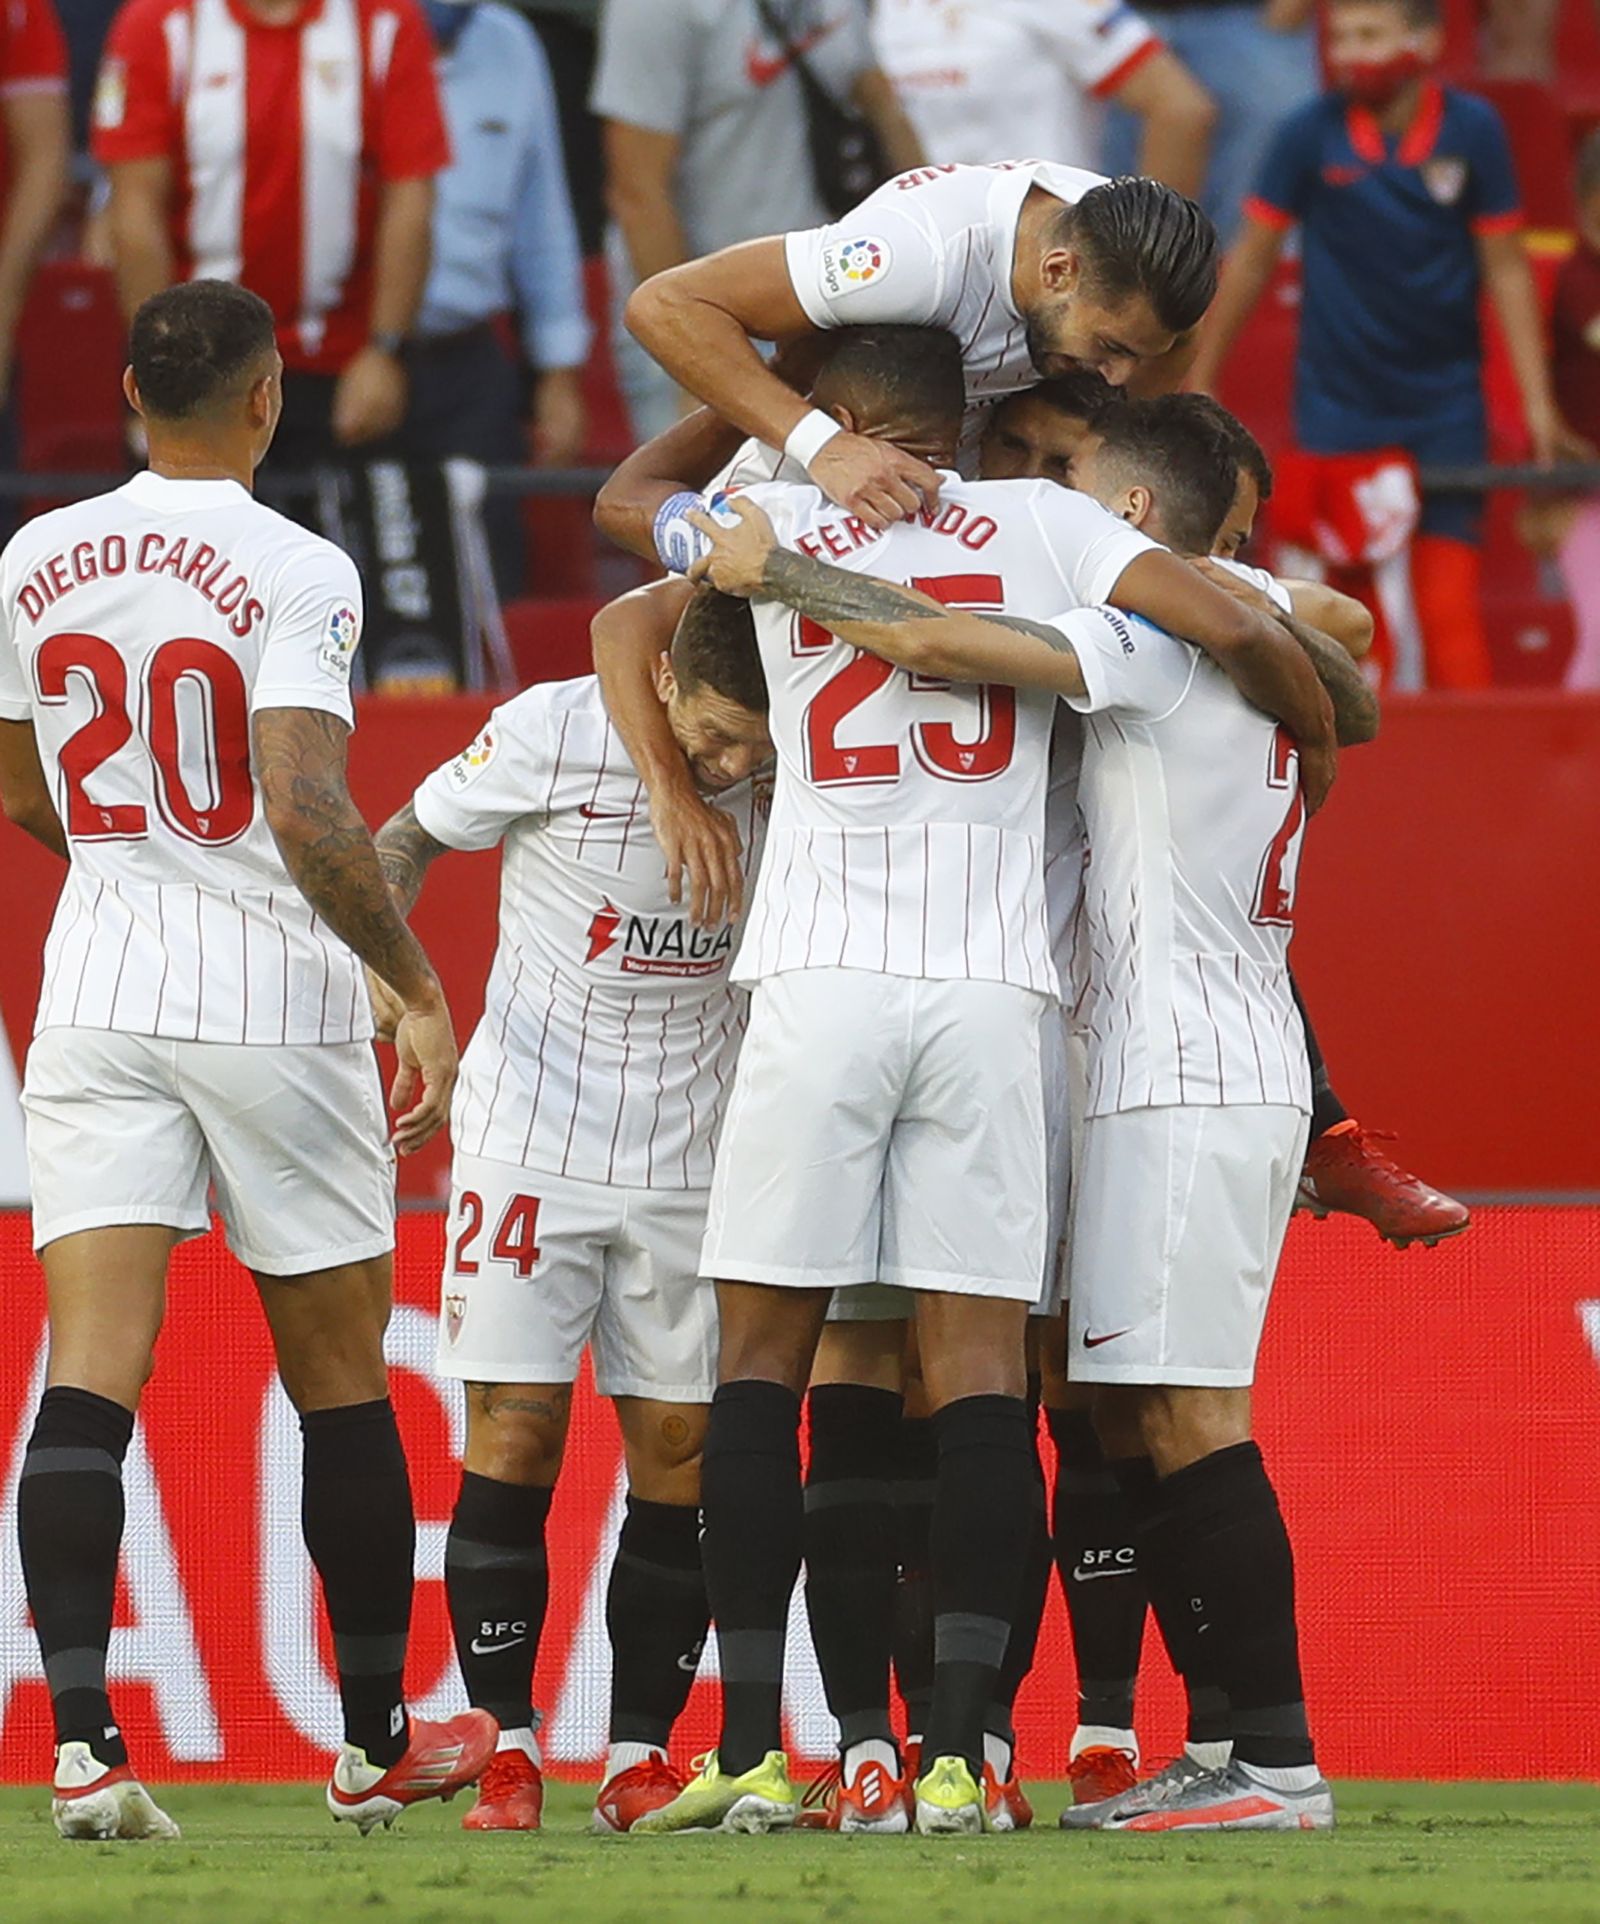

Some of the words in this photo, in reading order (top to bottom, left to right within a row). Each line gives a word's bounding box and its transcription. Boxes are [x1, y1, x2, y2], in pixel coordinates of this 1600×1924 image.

[823, 249, 840, 293] LaLiga
[16, 534, 127, 626] DIEGO
[137, 533, 265, 638] CARLOS
[32, 633, 255, 848] 20
[624, 915, 734, 959] NAGA
[453, 1190, 541, 1279] 24
[1082, 1547, 1135, 1564] SFC
[480, 1620, 527, 1637] SFC
